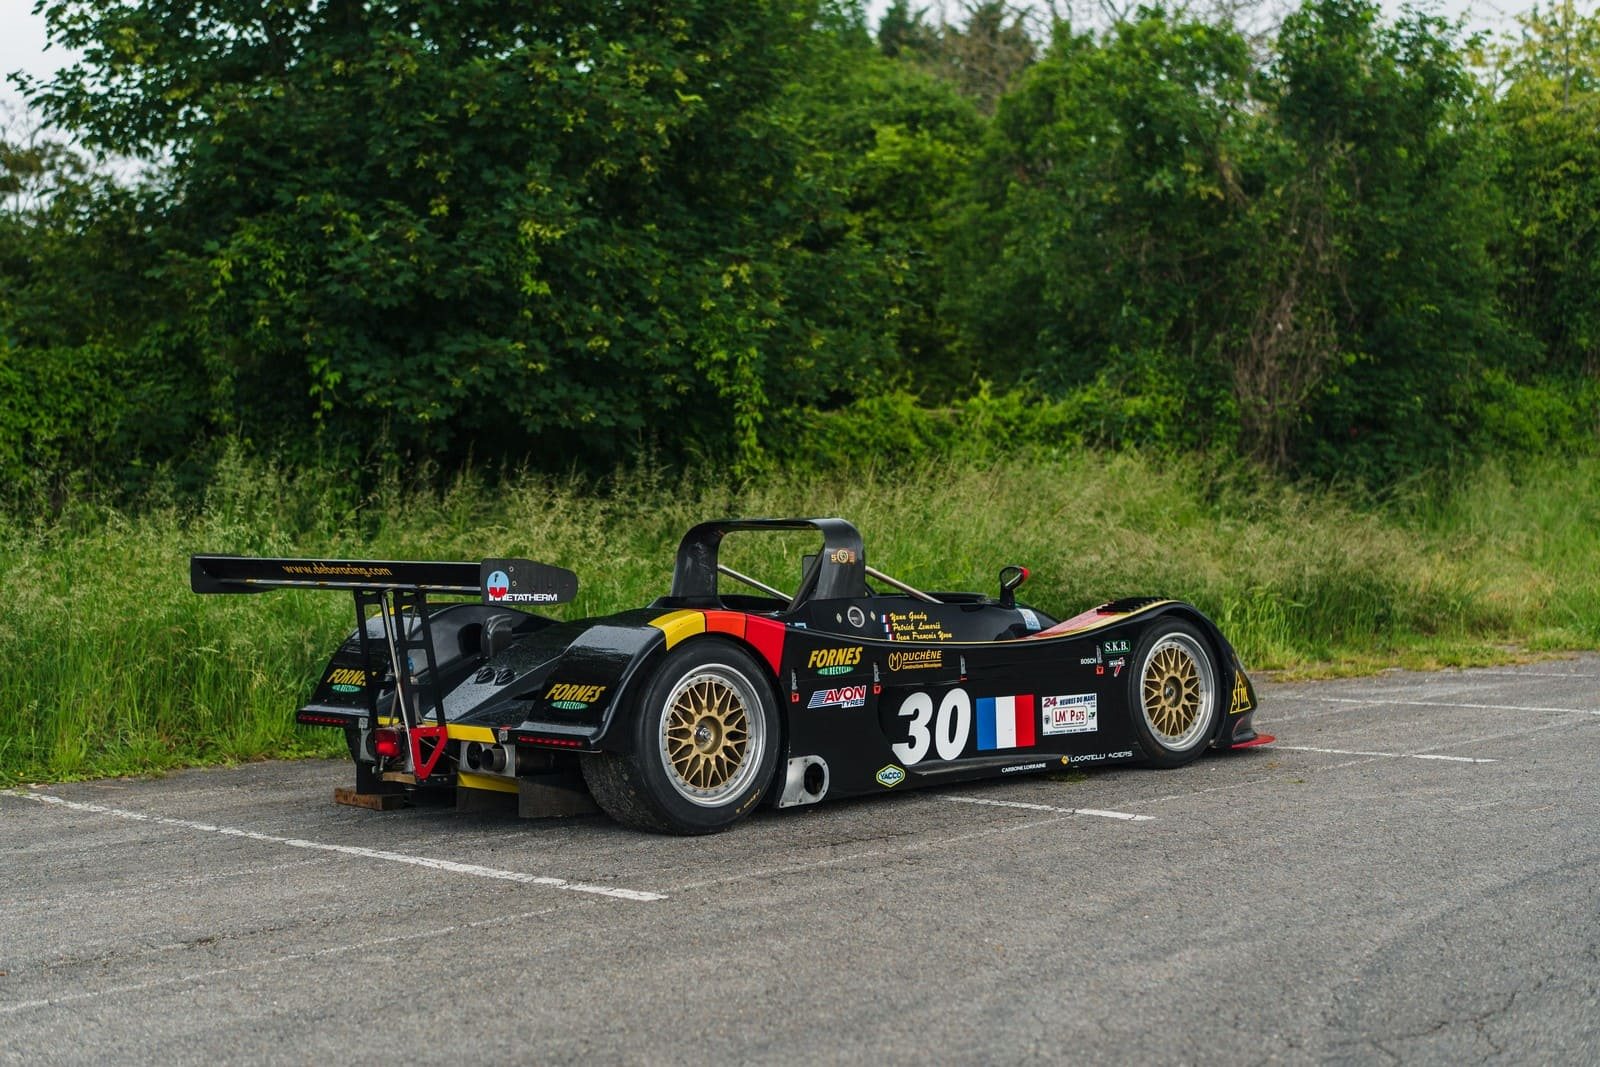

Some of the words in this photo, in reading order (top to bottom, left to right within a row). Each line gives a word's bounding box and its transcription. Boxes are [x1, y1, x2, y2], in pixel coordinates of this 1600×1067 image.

[282, 562, 393, 578] www.deboracing.com
[892, 623, 915, 632] Patrick
[896, 632, 910, 641] Jean
[912, 631, 936, 640] François
[1105, 641, 1129, 652] S.K.B.
[808, 647, 863, 668] FORNES
[902, 650, 942, 661] DUCHÊNE
[326, 668, 377, 687] FORNE
[544, 683, 607, 703] FORNES
[824, 685, 866, 703] AVON
[842, 699, 865, 708] TYRES
[1043, 697, 1058, 708] 24
[1059, 698, 1076, 706] HEURES
[1076, 696, 1083, 704] DU
[1083, 694, 1096, 702] MANS
[891, 687, 971, 766] 30
[1070, 753, 1106, 763] LOCATELLI
[1108, 750, 1133, 759] ACIERS
[1001, 764, 1023, 773] CARBONE
[1023, 762, 1046, 771] LORRAINE
[880, 771, 902, 780] YACCO
